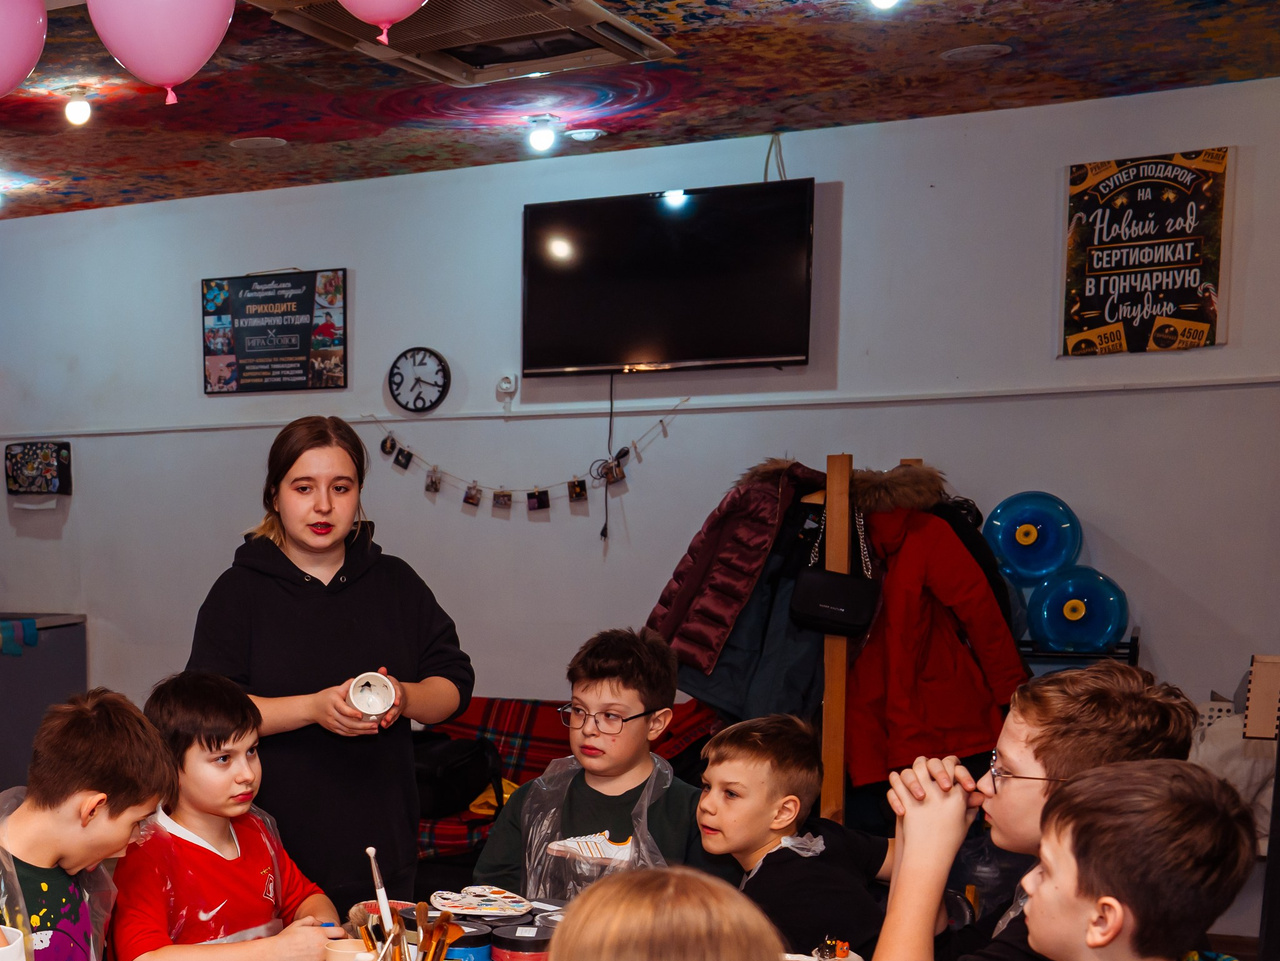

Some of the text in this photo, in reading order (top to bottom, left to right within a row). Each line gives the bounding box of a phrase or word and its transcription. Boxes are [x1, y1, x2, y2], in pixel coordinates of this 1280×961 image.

[1099, 167, 1137, 194] СУПЕР
[1139, 164, 1196, 185] ПОДАРОК
[1137, 187, 1152, 201] НА
[1089, 201, 1199, 245] Новый год
[1093, 242, 1195, 269] СЕРТИФИКАТ
[1085, 268, 1200, 296] В ГОНЧАРНУЮ
[245, 302, 297, 314] ПРИХОДИТЕ
[1105, 289, 1177, 326] Студию
[234, 314, 310, 327] В КУЛИНАРНУЮ СТУДИЮ
[1097, 330, 1122, 346] 3500
[1180, 327, 1205, 341] 4500
